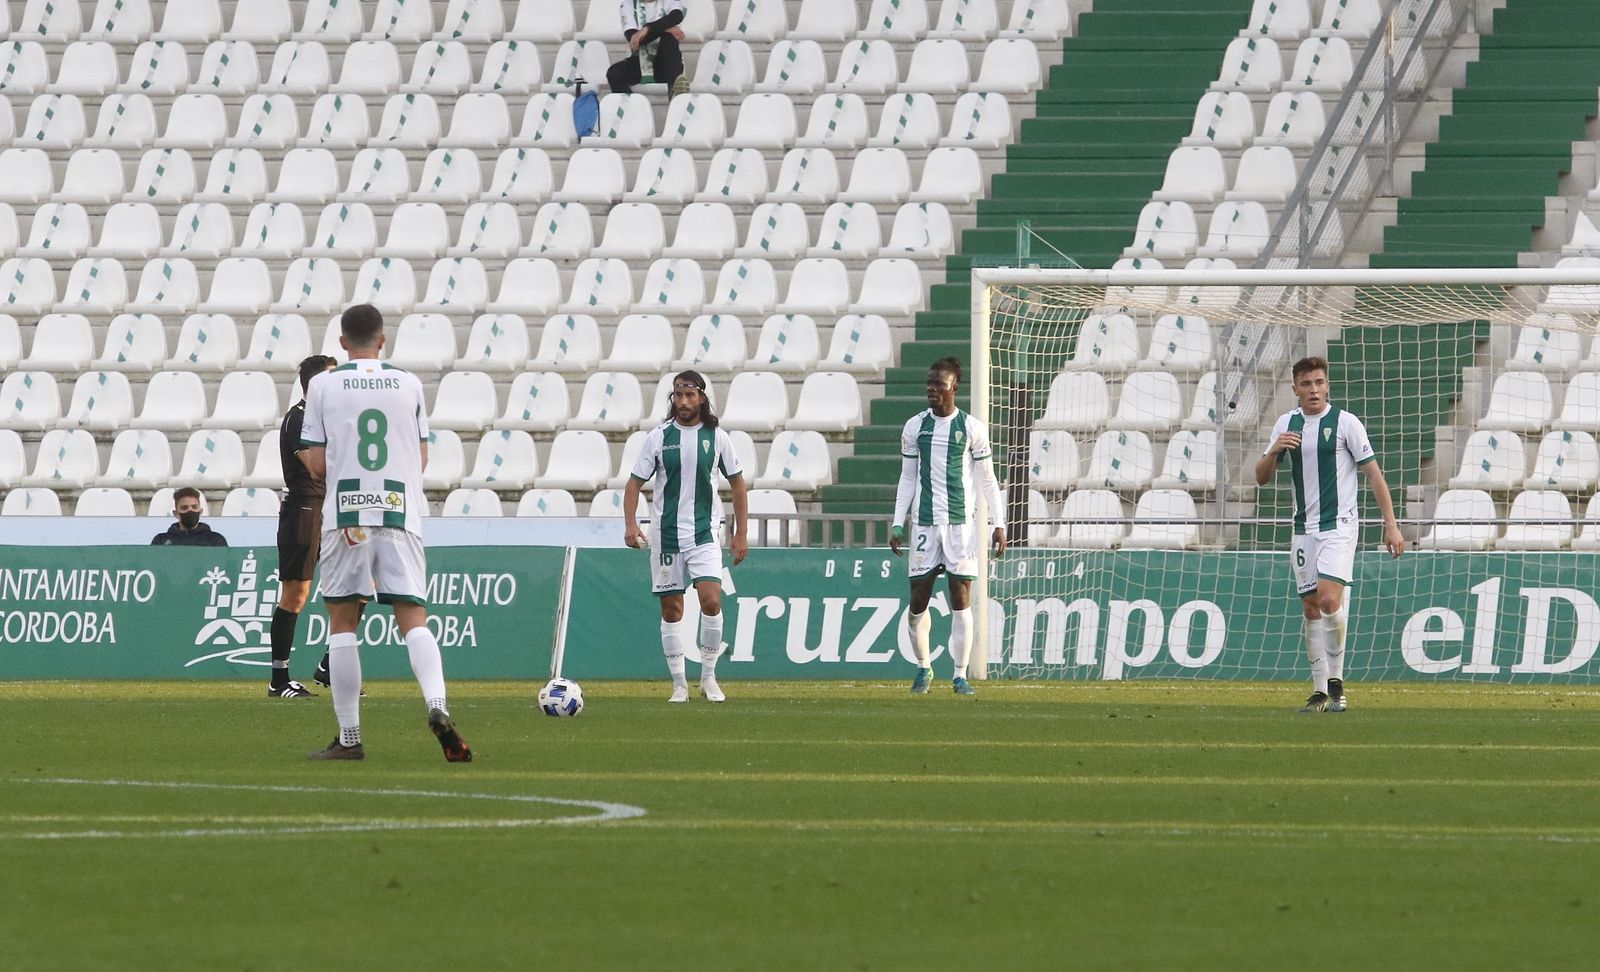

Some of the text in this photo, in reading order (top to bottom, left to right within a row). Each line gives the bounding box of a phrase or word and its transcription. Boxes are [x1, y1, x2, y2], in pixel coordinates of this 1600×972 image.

[357, 408, 388, 472] 8
[916, 533, 927, 552] 2
[659, 552, 673, 567] 16
[1296, 548, 1306, 568] 6
[989, 561, 1085, 580] 1904
[0, 568, 156, 602] NTAMIENTO
[0, 610, 116, 643] ORDOBA
